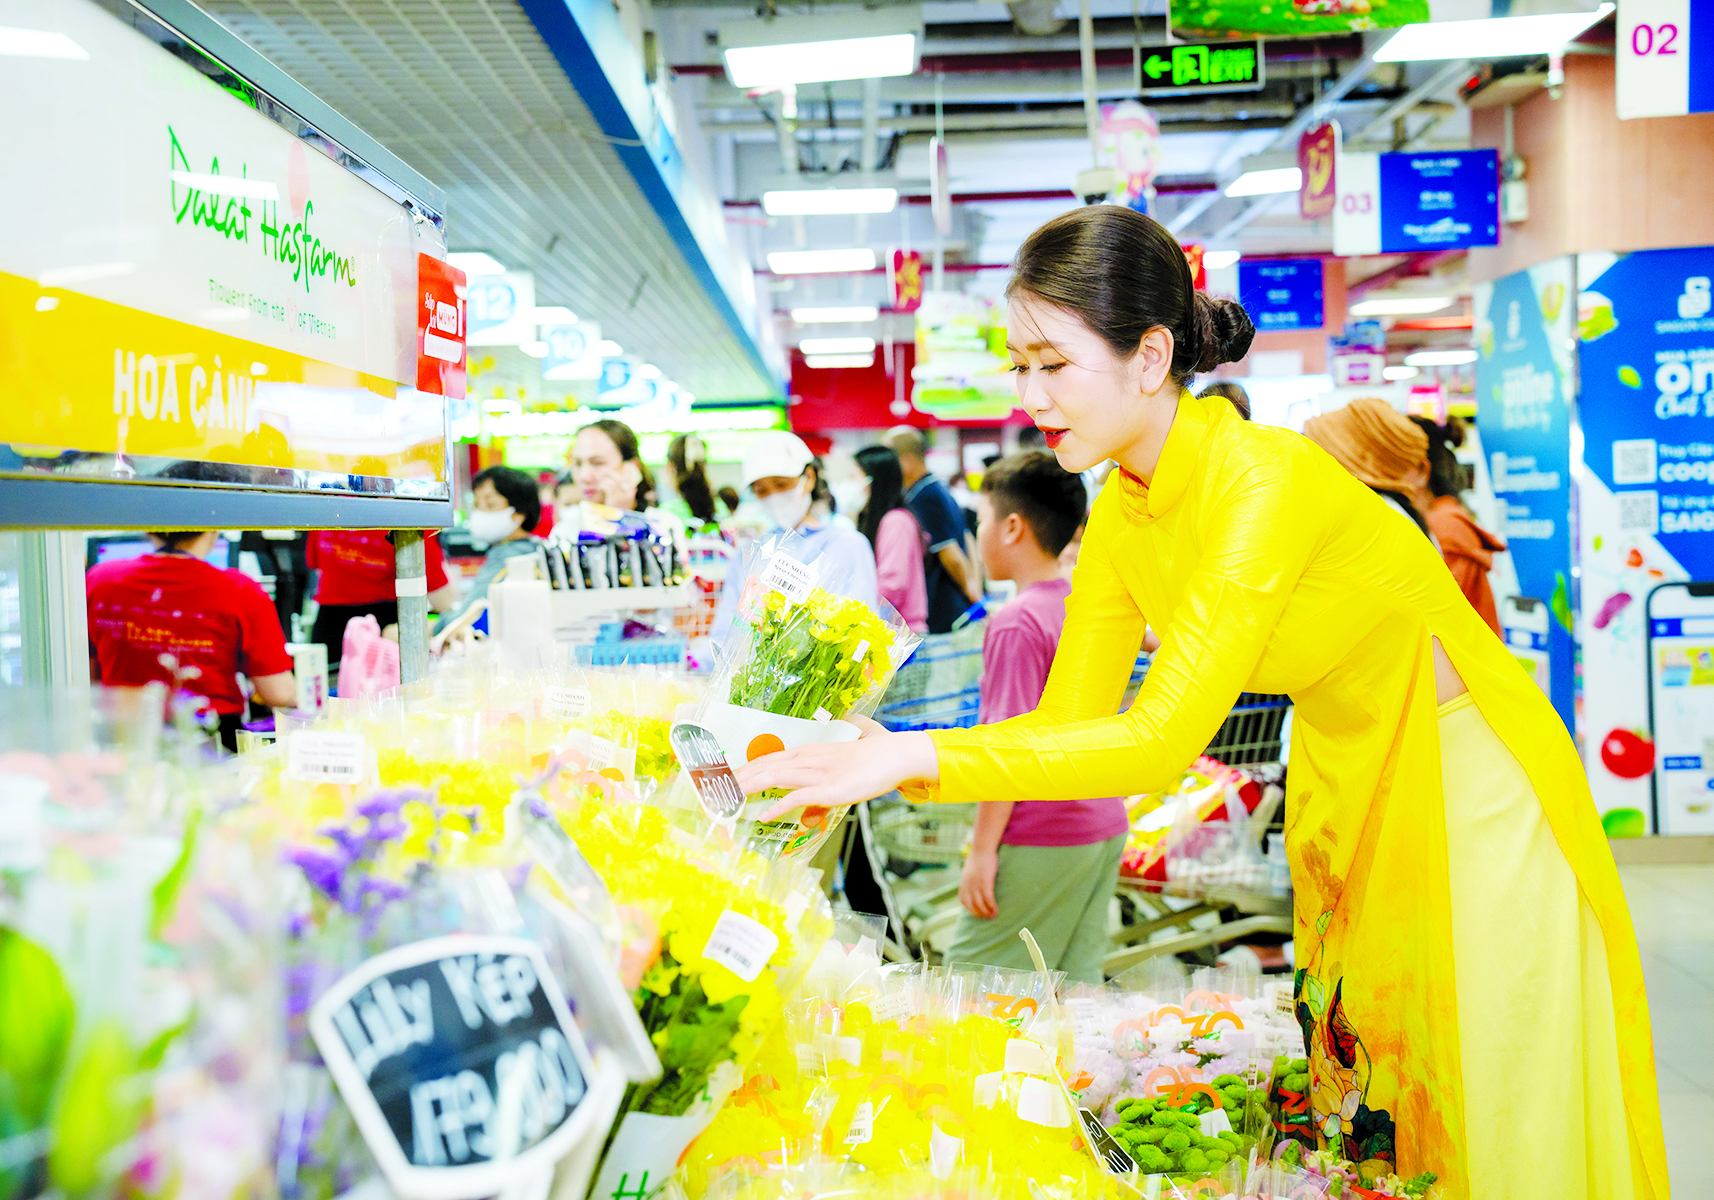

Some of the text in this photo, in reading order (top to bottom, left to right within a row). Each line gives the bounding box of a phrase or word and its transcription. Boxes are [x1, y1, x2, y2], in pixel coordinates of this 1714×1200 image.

[1632, 24, 1678, 56] 02
[1209, 61, 1255, 83] EXIT
[168, 124, 356, 293] Dalat Hasfarm
[1343, 193, 1372, 214] 03
[113, 348, 180, 423] HOA
